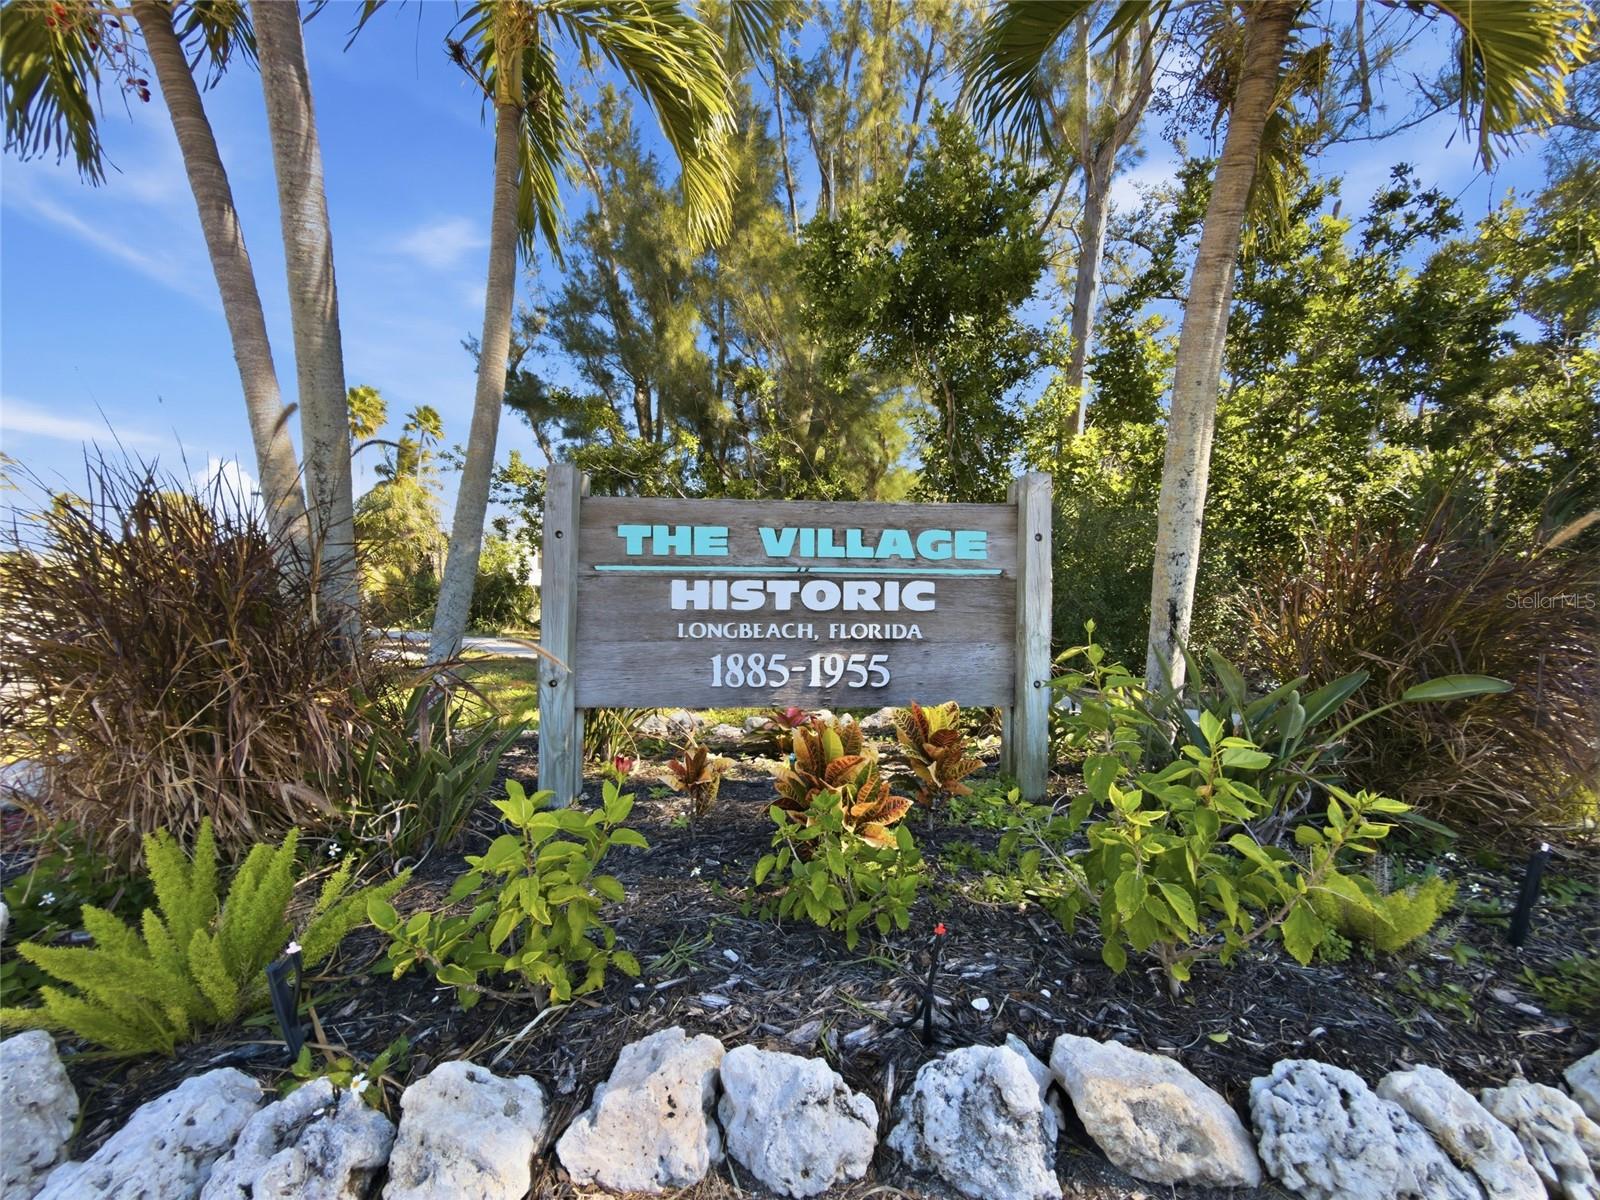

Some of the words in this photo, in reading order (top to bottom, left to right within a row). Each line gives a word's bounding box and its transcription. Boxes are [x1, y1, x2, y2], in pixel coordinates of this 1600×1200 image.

[617, 524, 729, 556] THE
[758, 527, 988, 560] VILLAGE
[670, 579, 936, 612] HISTORIC
[677, 622, 819, 641] LONGBEACH,
[828, 623, 923, 640] FLORIDA
[710, 653, 891, 689] 1885-1955
